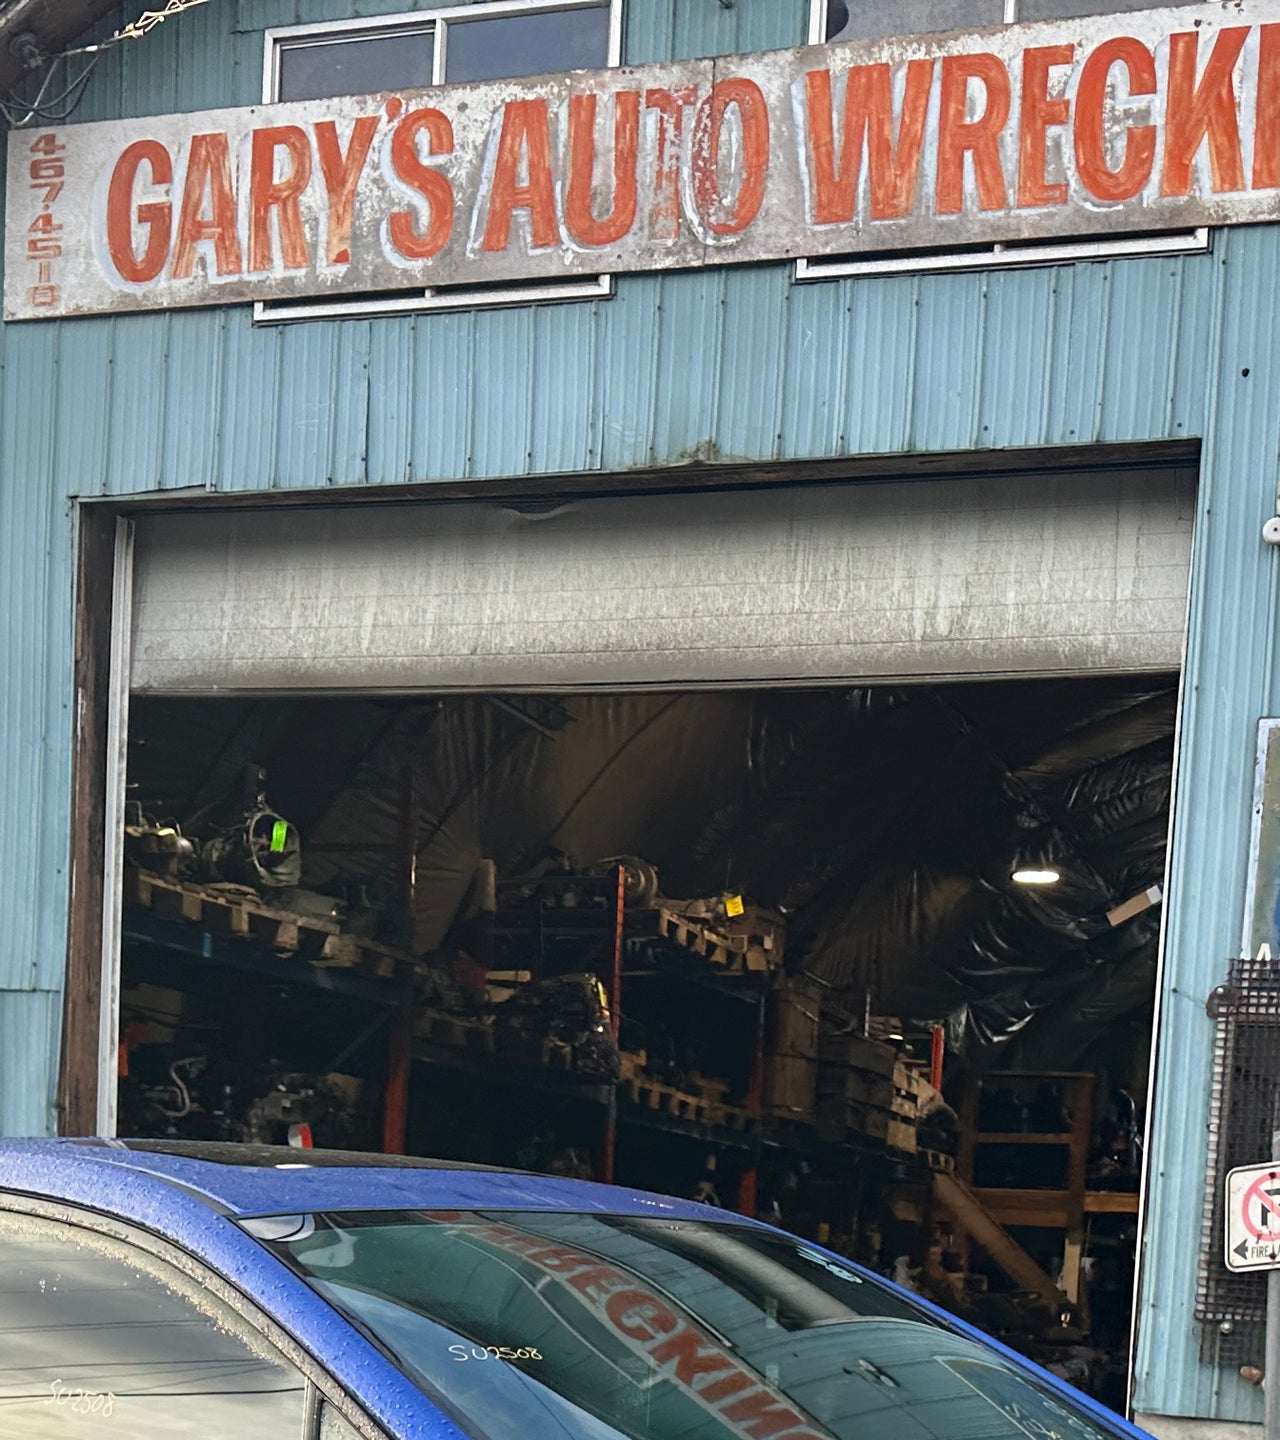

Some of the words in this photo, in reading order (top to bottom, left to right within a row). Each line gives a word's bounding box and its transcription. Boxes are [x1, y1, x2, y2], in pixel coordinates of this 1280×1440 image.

[100, 98, 454, 286] GARY'S
[472, 78, 770, 252] AUTO
[1251, 1245, 1270, 1259] FIRE
[447, 1344, 543, 1361] SU2508
